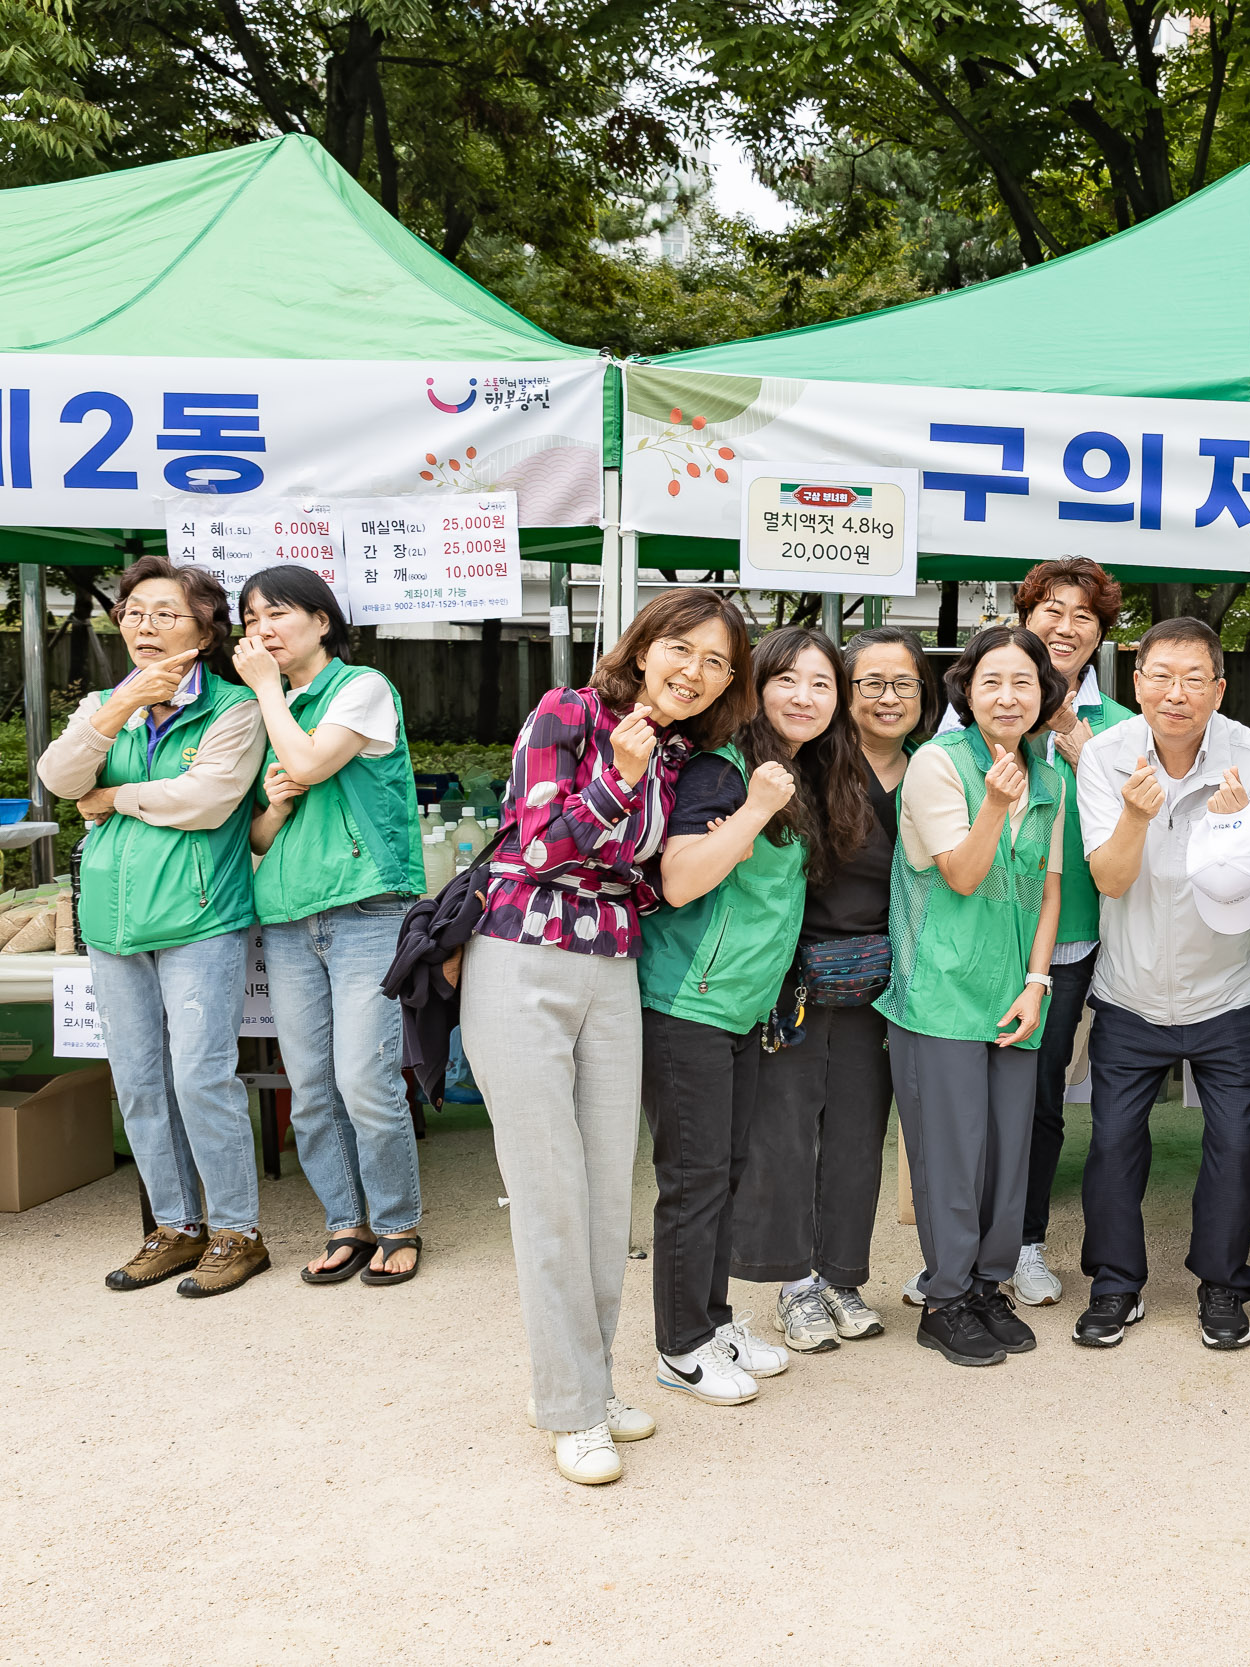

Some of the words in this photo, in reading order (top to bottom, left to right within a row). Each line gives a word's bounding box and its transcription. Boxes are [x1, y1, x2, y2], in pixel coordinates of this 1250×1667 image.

[181, 522, 196, 536] 식
[274, 521, 330, 536] 6,000원
[442, 515, 505, 531] 25,000원
[764, 511, 834, 534] 멸치액젓
[842, 517, 894, 539] 4.8kg
[182, 546, 196, 560] 식
[276, 545, 334, 560] 4,000원
[363, 545, 378, 559] 간
[444, 538, 506, 555] 25,000원
[782, 542, 870, 565] 20,000원
[364, 569, 378, 584] 참
[446, 562, 508, 579] 10,000원
[404, 588, 443, 599] 계좌이체
[448, 587, 467, 598] 가능
[64, 984, 74, 995] 식
[64, 1001, 74, 1011] 식
